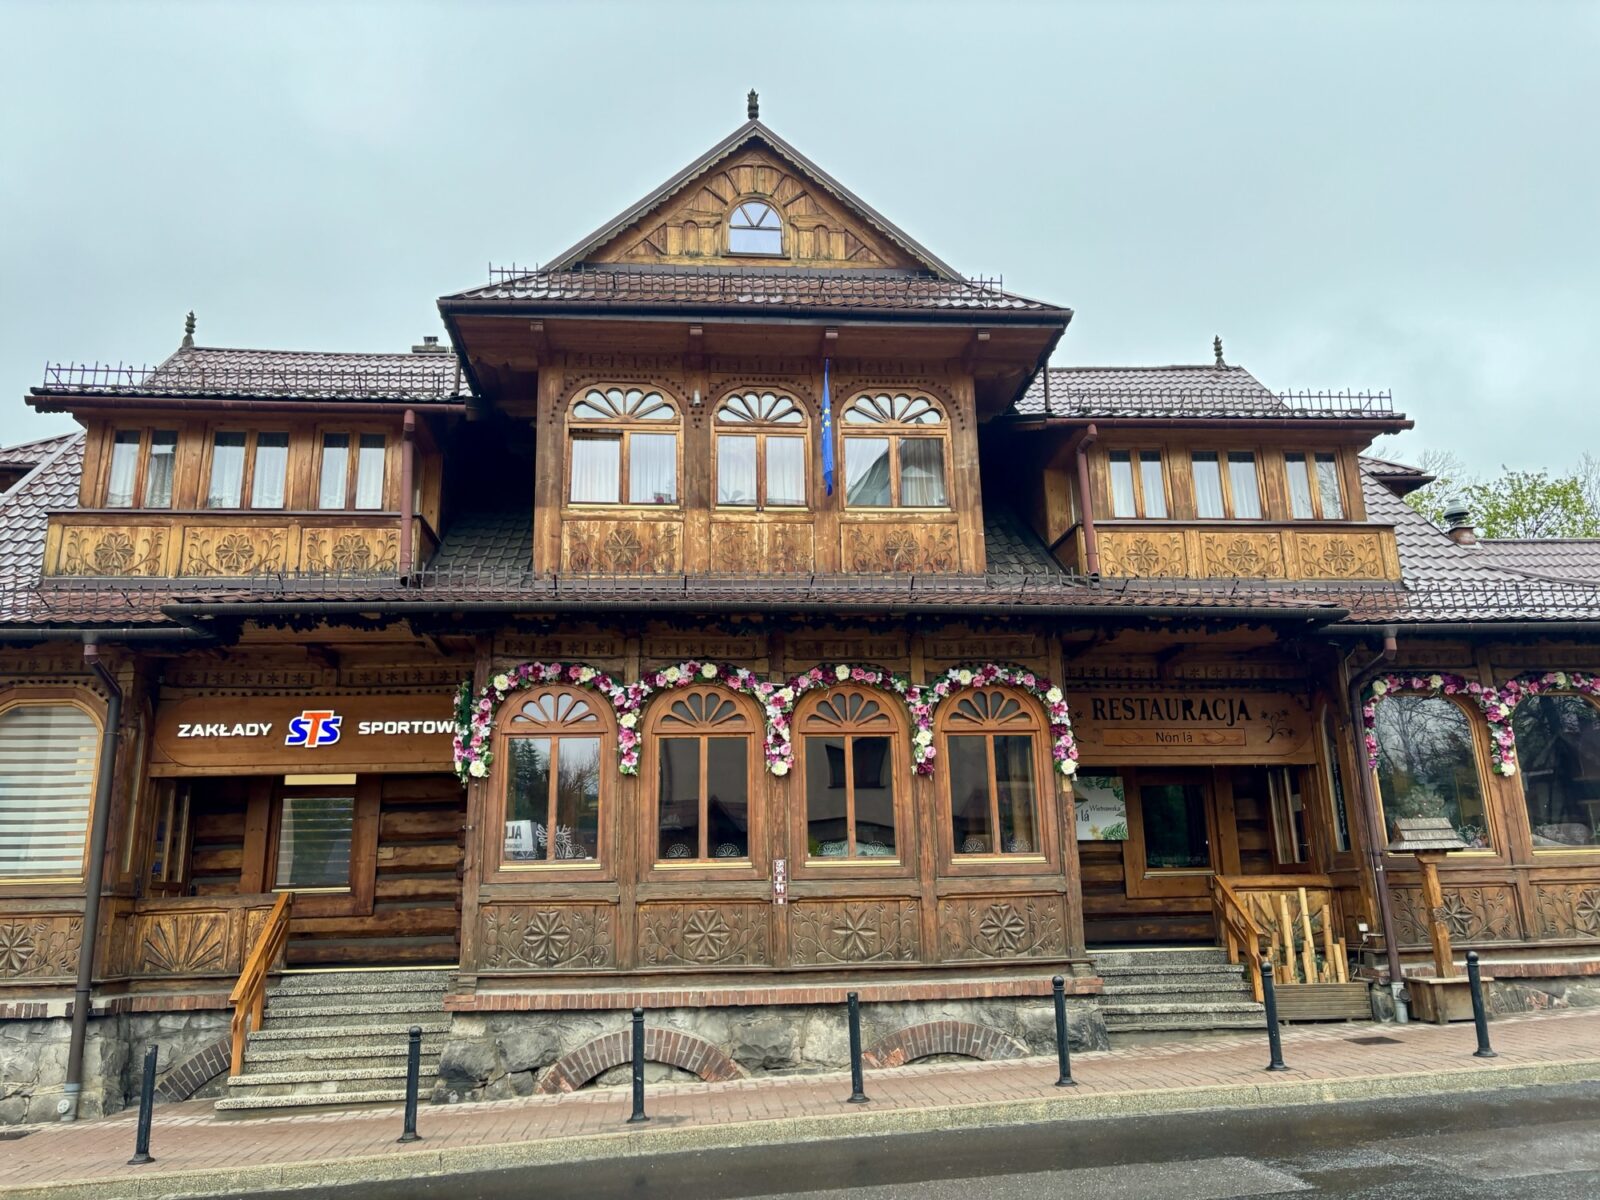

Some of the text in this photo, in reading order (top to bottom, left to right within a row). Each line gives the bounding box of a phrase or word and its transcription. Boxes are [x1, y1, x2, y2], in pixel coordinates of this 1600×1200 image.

[1091, 698, 1252, 726] RESTAURACJA
[177, 723, 272, 737] ZAKŁADY
[285, 710, 342, 748] STS
